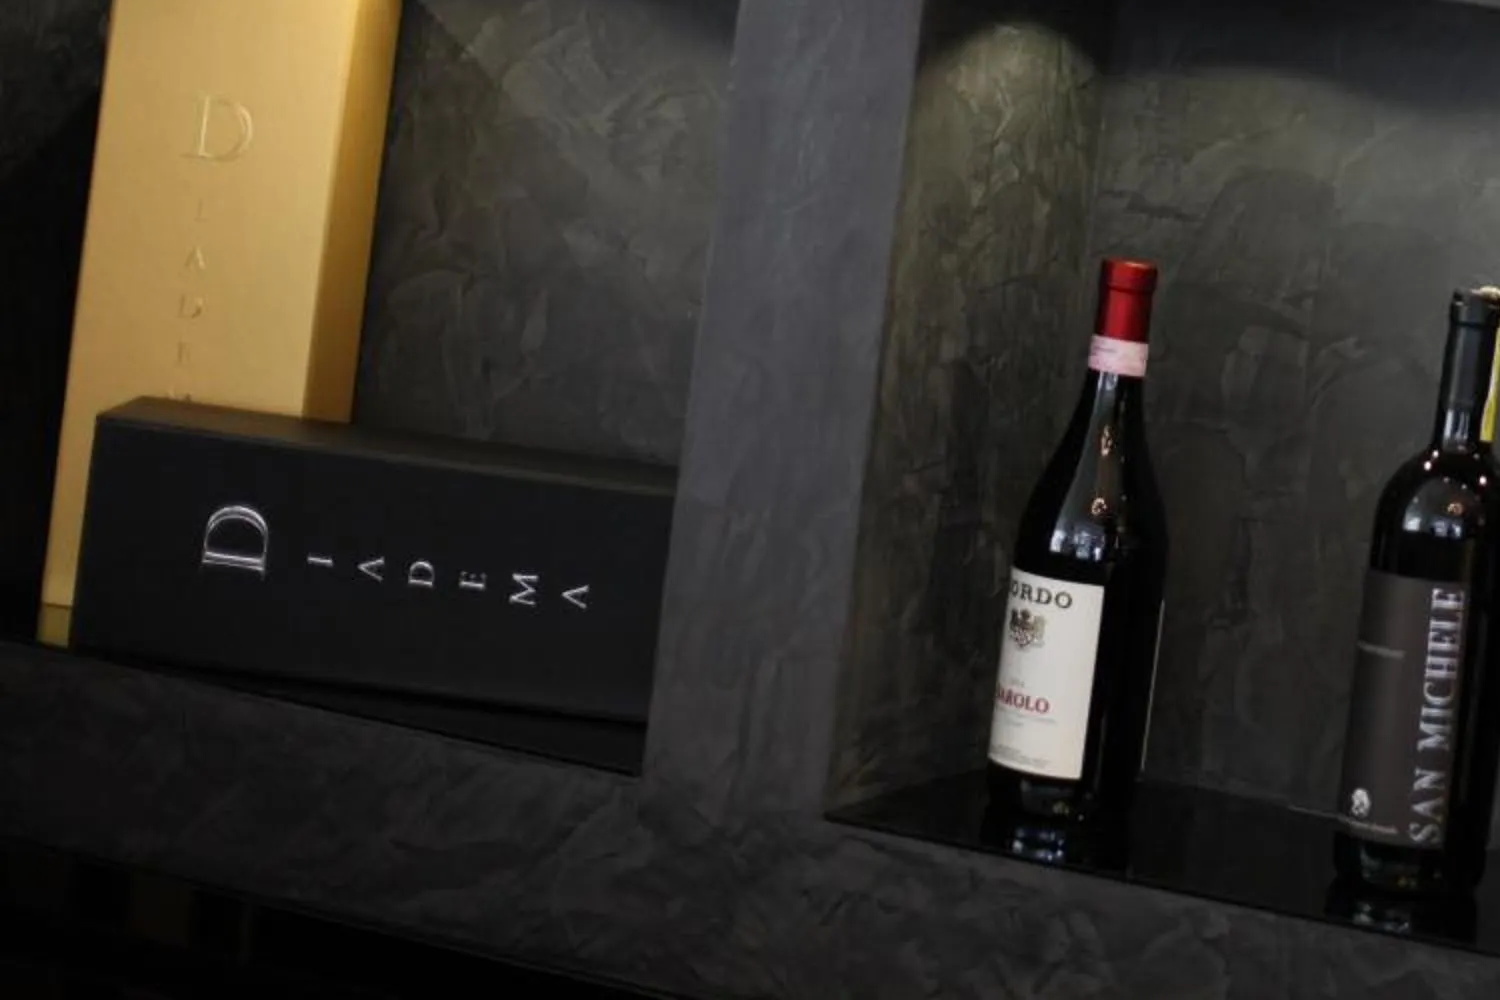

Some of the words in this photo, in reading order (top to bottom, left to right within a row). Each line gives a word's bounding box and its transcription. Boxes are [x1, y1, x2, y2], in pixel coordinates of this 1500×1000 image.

[1009, 578, 1074, 610] ORDO
[1416, 587, 1466, 752] MICHELE
[995, 682, 1051, 715] AROLO
[1408, 766, 1446, 844] SAN
